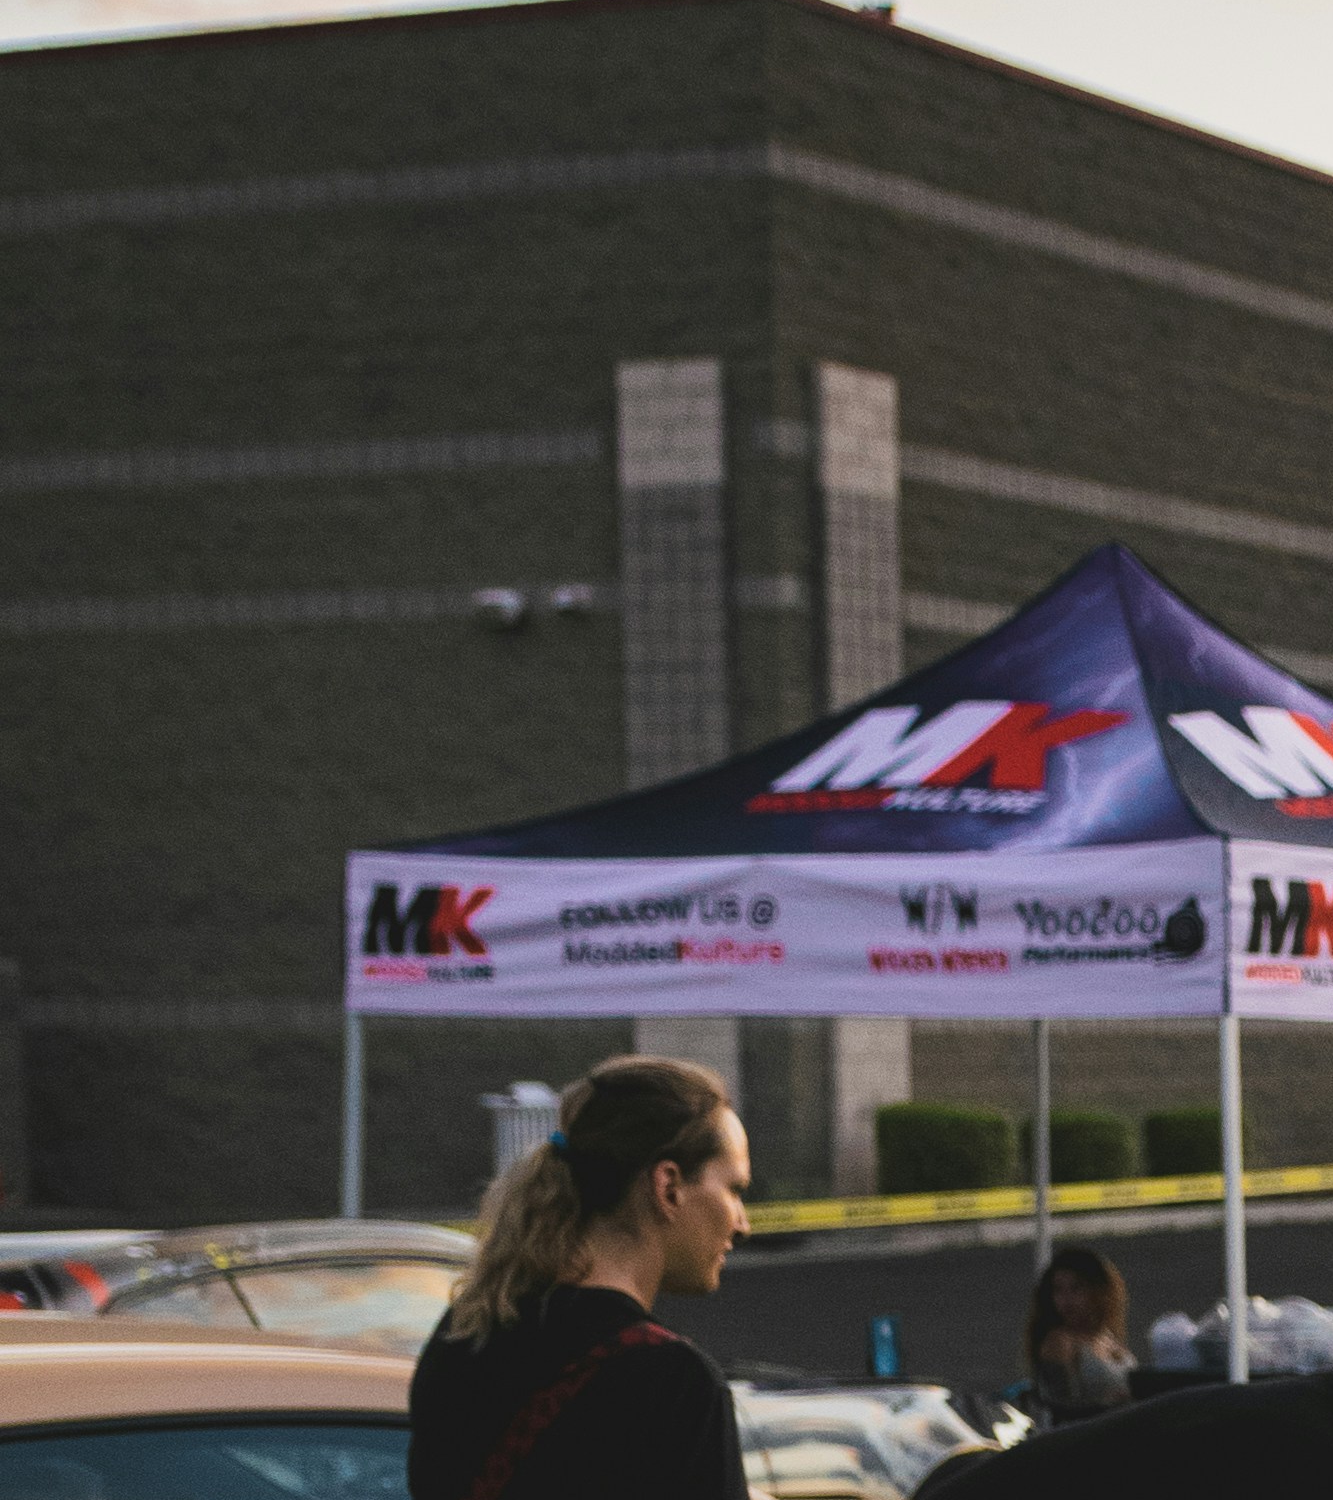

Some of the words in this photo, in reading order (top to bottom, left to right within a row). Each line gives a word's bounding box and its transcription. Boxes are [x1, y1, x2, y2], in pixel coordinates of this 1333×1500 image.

[769, 699, 1131, 792] MK
[362, 882, 497, 957] MK
[560, 895, 690, 929] FOLLOW
[699, 896, 742, 925] US
[748, 893, 778, 931] @
